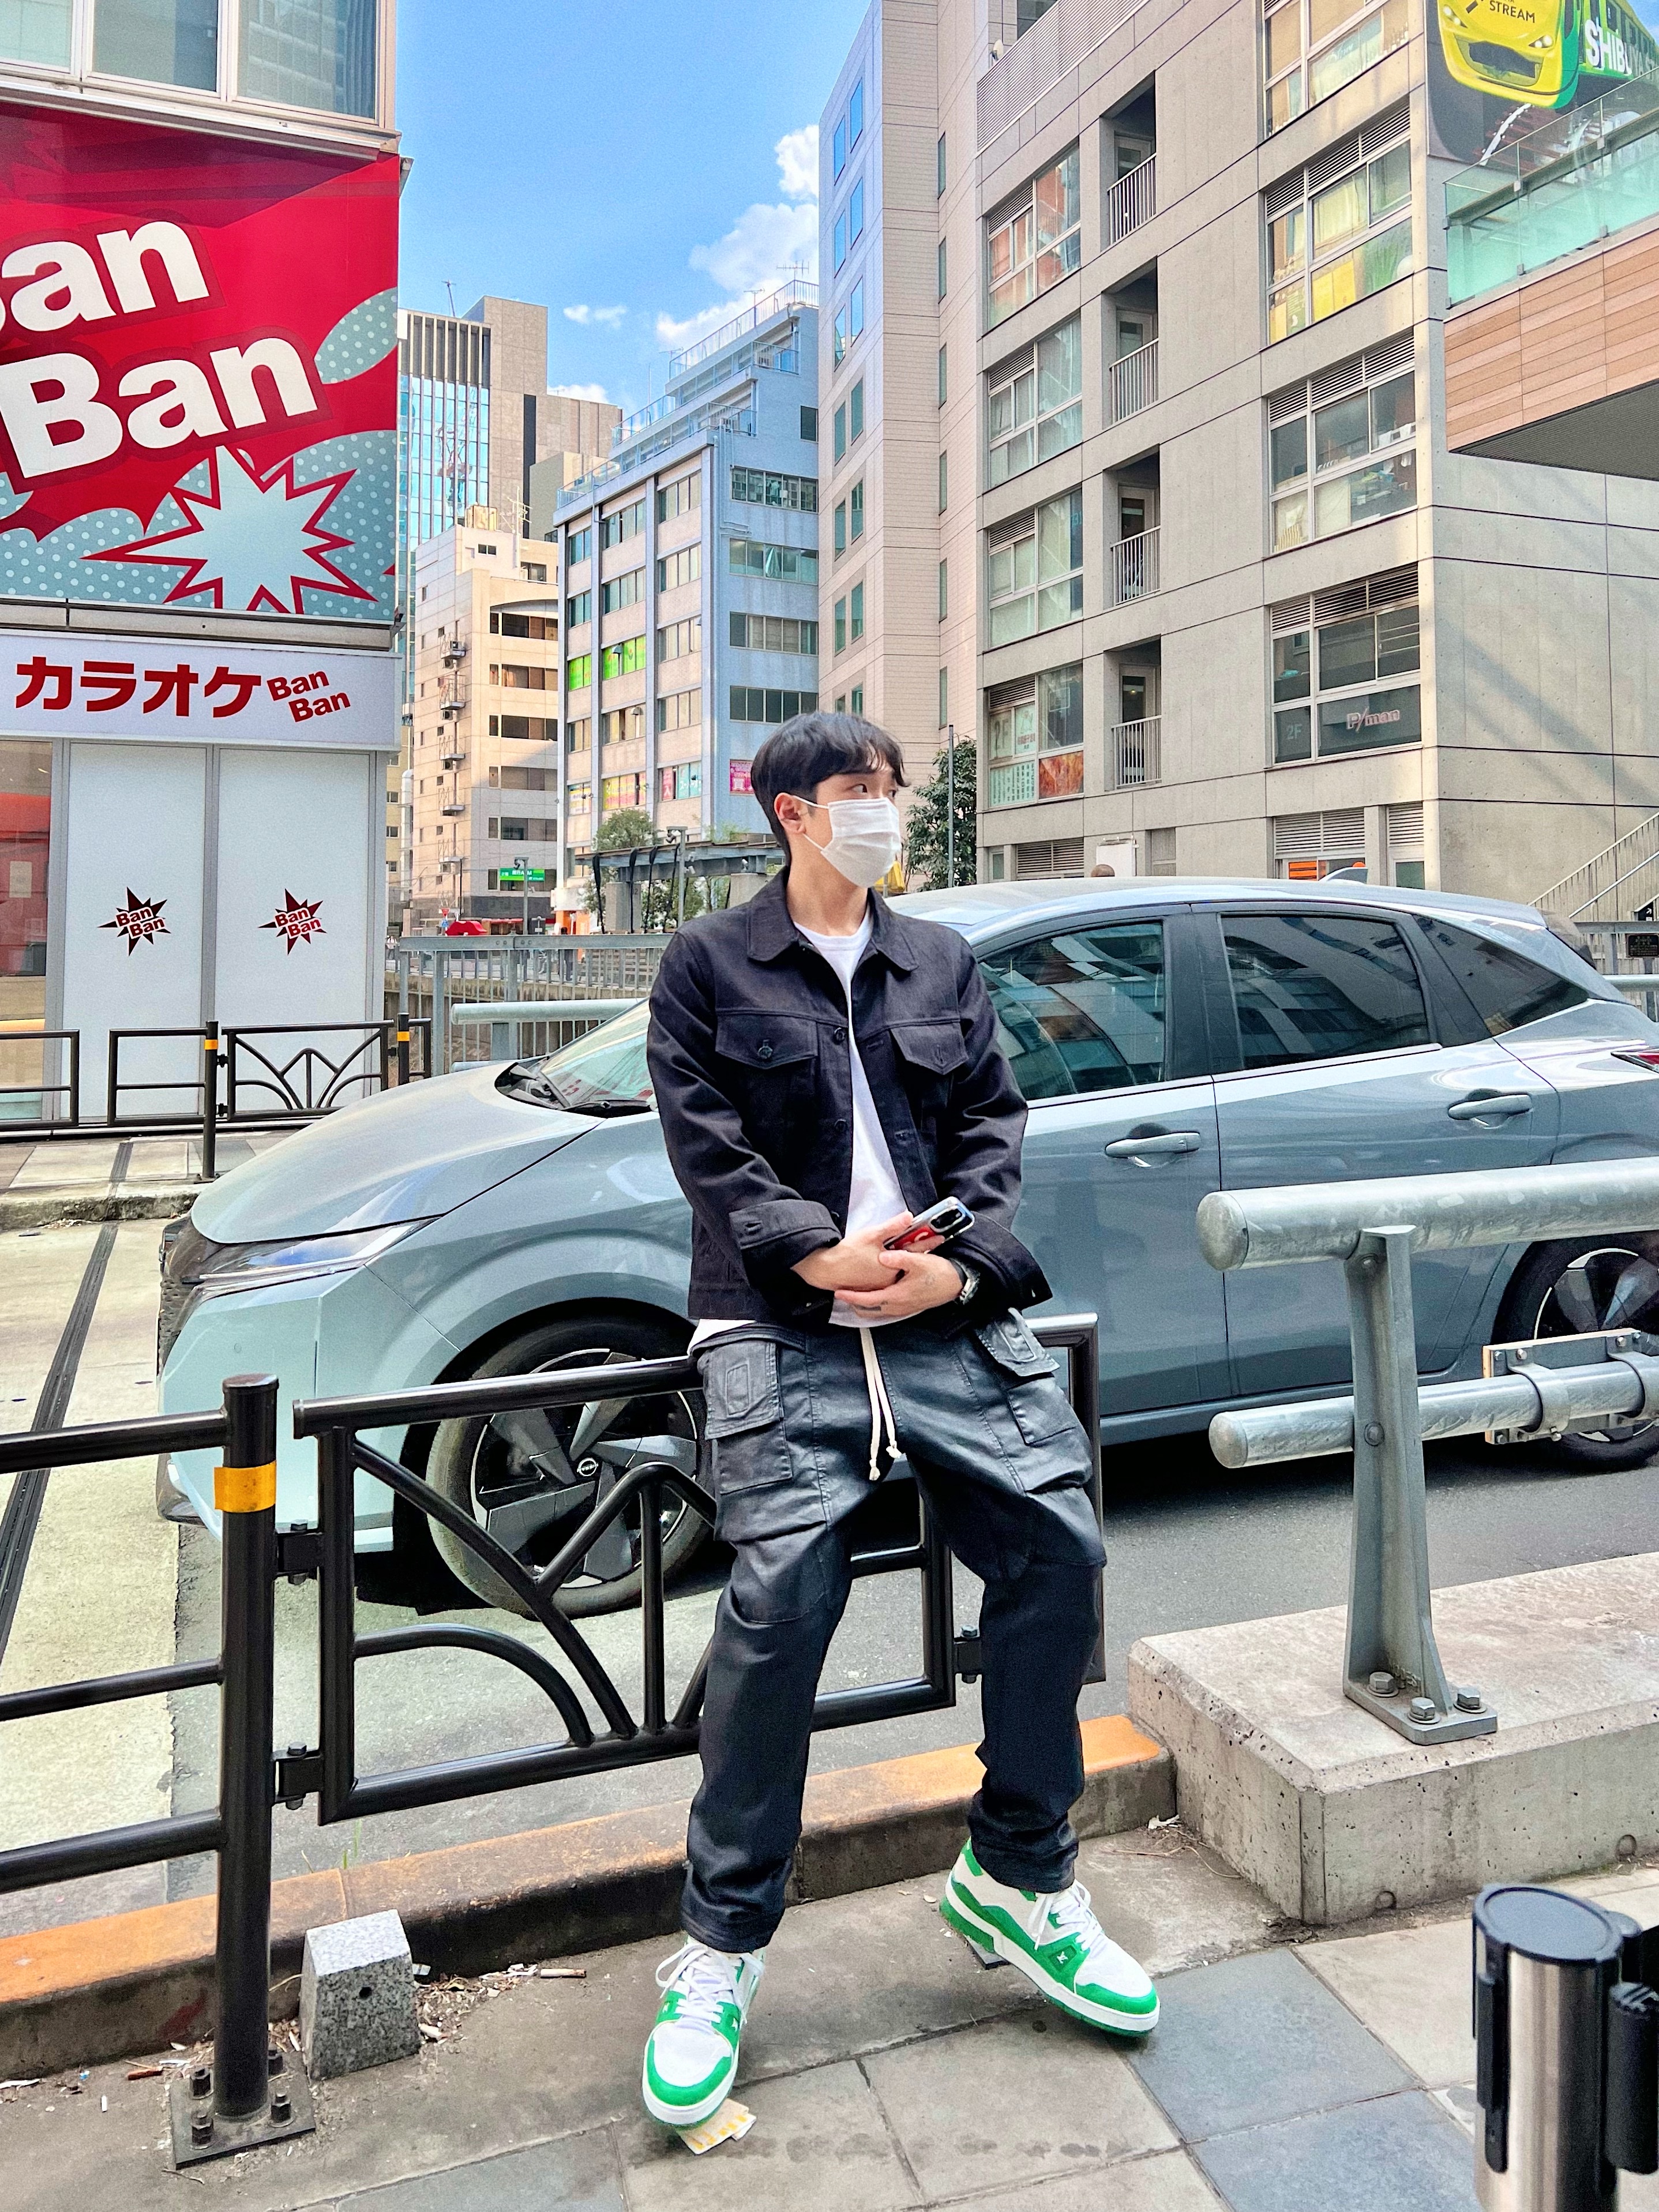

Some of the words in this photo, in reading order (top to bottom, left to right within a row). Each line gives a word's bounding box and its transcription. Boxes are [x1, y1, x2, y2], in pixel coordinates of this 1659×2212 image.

[1489, 1, 1535, 23] STREAM
[0, 221, 209, 333] an
[0, 337, 317, 478] Ban
[15, 656, 262, 718] カラオケ
[267, 671, 329, 701] Ban
[288, 692, 351, 723] Ban
[1286, 723, 1302, 741] 2F
[116, 908, 152, 927] Ban
[129, 919, 165, 937] Ban
[275, 910, 309, 927] Ban
[288, 919, 321, 937] Ban
